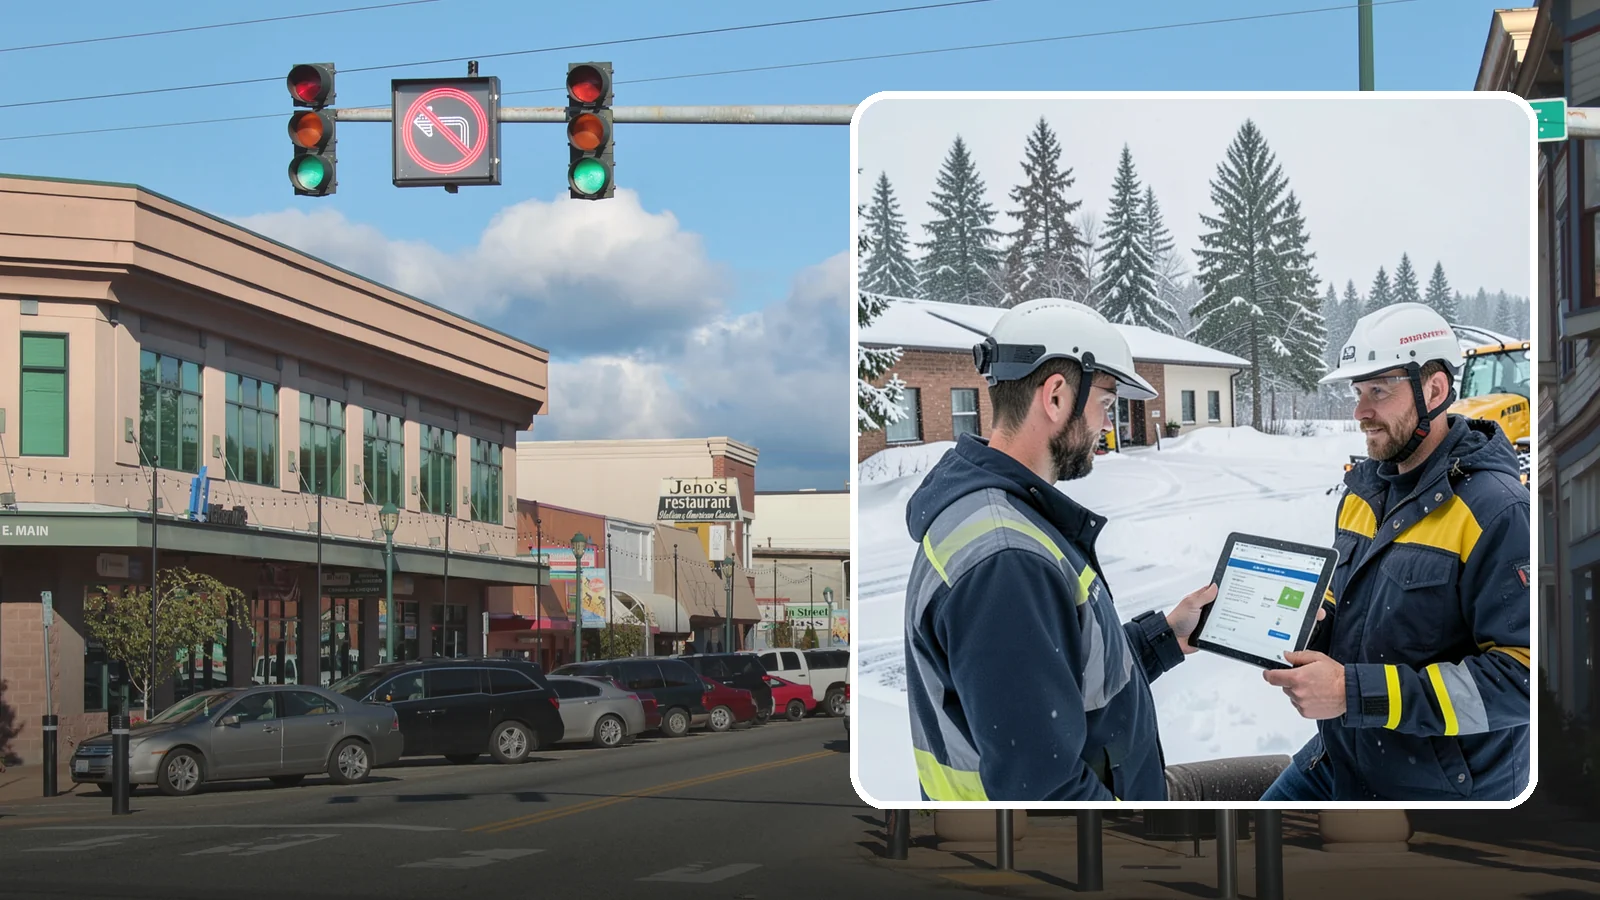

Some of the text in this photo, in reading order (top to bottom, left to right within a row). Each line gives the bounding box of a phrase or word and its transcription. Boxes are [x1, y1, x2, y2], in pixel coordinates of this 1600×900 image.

[669, 480, 727, 494] Jeno's
[665, 496, 731, 509] restaurant
[686, 509, 714, 519] American
[715, 509, 738, 519] Cuisine
[2, 525, 49, 536] E. MAIN
[797, 606, 828, 617] Street
